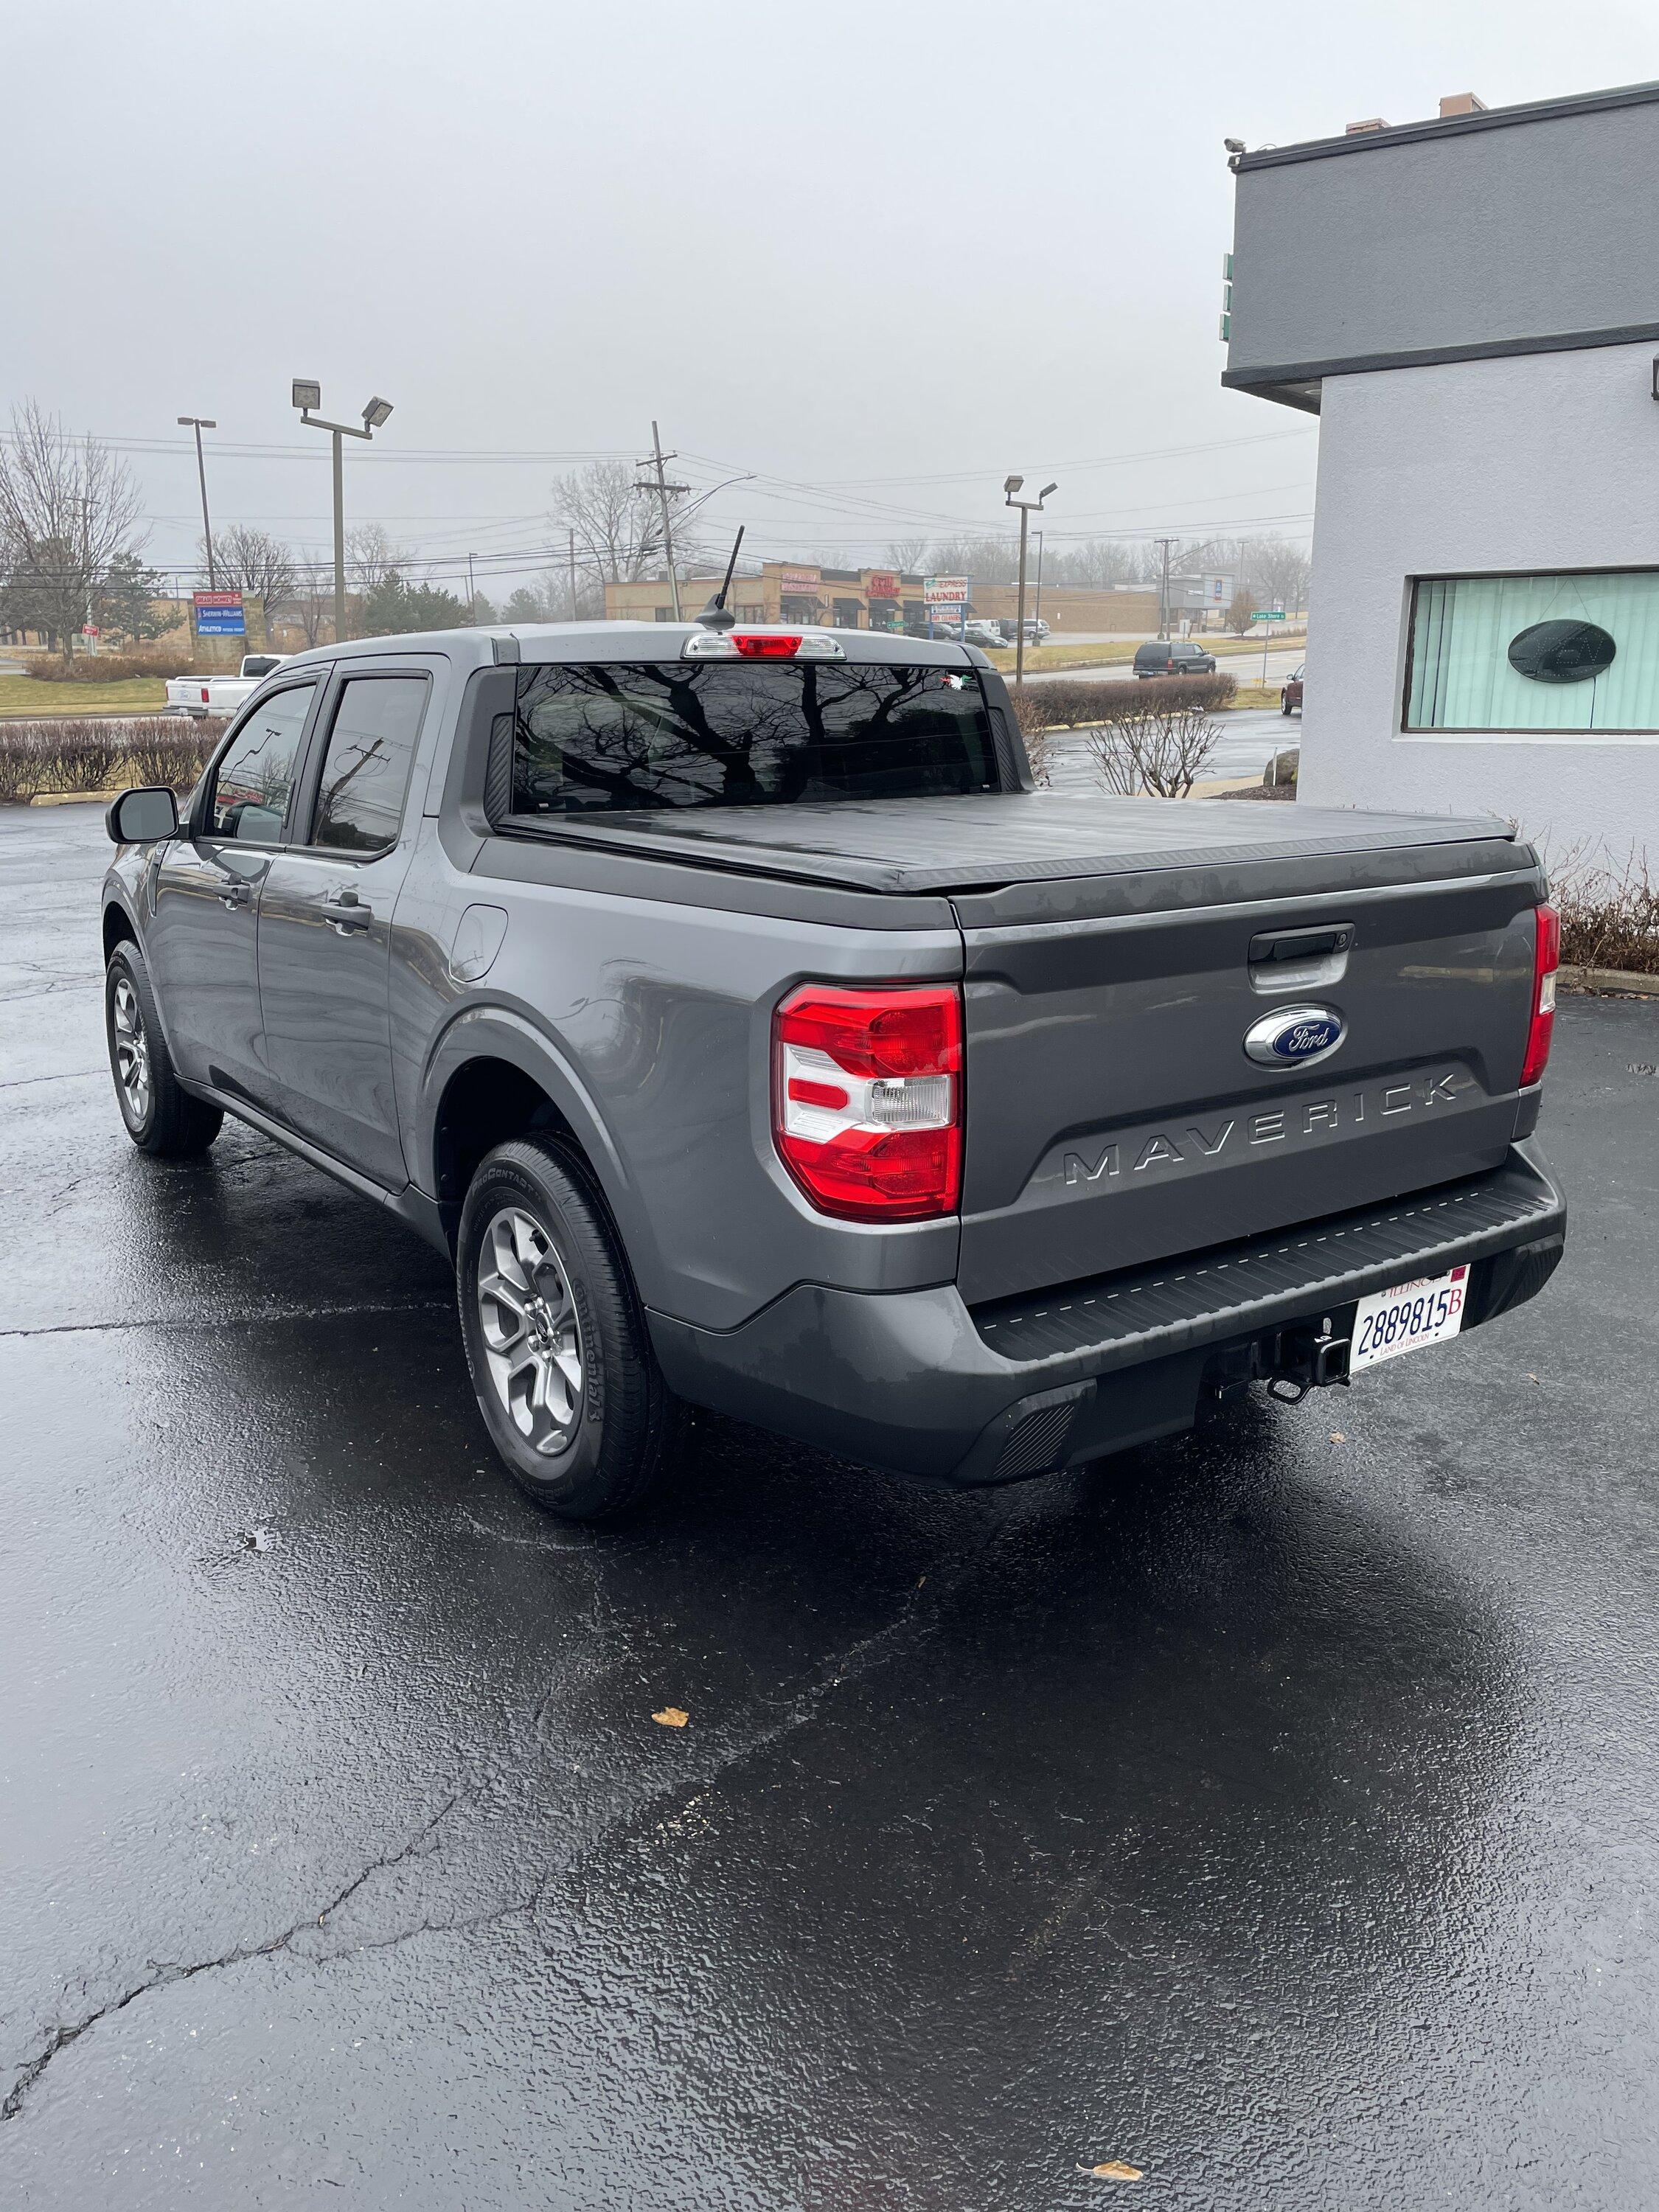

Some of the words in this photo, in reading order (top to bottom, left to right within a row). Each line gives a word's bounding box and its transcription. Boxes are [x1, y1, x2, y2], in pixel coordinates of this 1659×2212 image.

[925, 591, 967, 602] LAUNDRY
[1288, 1023, 1331, 1053] Ford
[1063, 1073, 1457, 1185] MAVERICK
